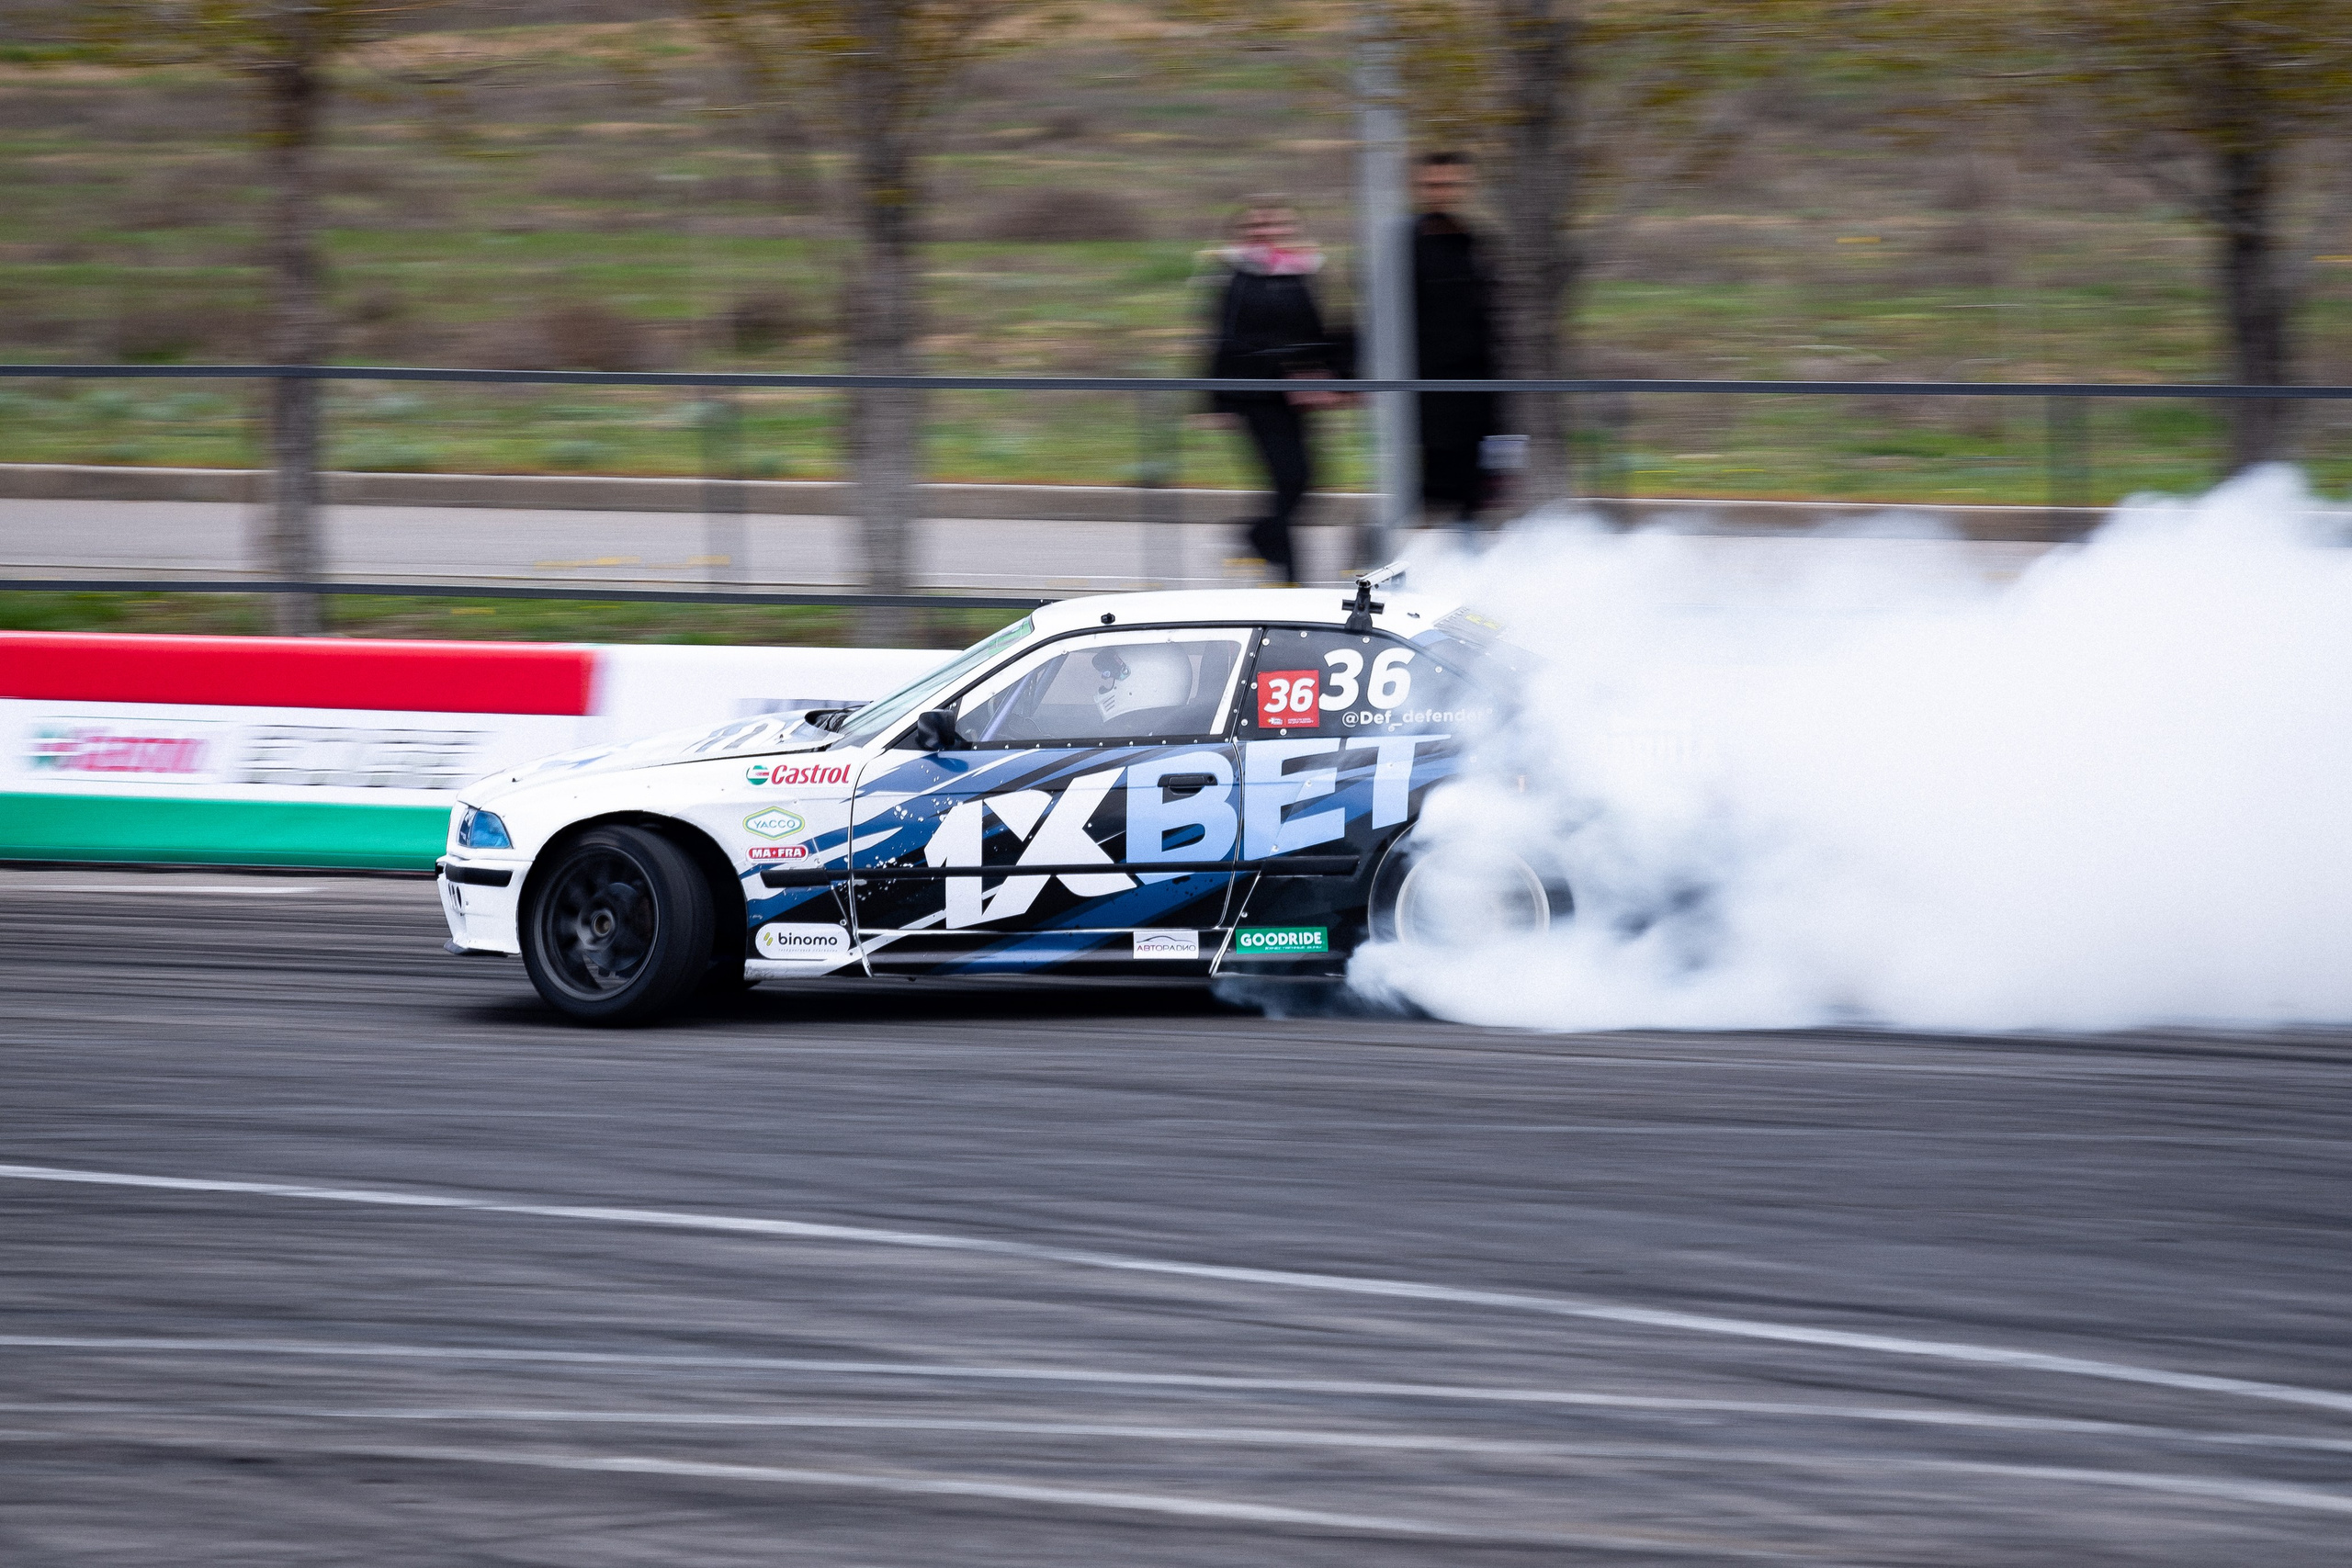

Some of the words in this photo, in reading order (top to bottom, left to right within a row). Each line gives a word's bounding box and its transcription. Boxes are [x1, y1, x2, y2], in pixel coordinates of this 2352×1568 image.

[1318, 648, 1416, 712] 36
[1263, 678, 1316, 713] 36
[771, 763, 852, 785] Castrol
[753, 819, 797, 829] YACCO
[777, 931, 838, 946] binomo
[1240, 931, 1323, 947] GOODRIDE
